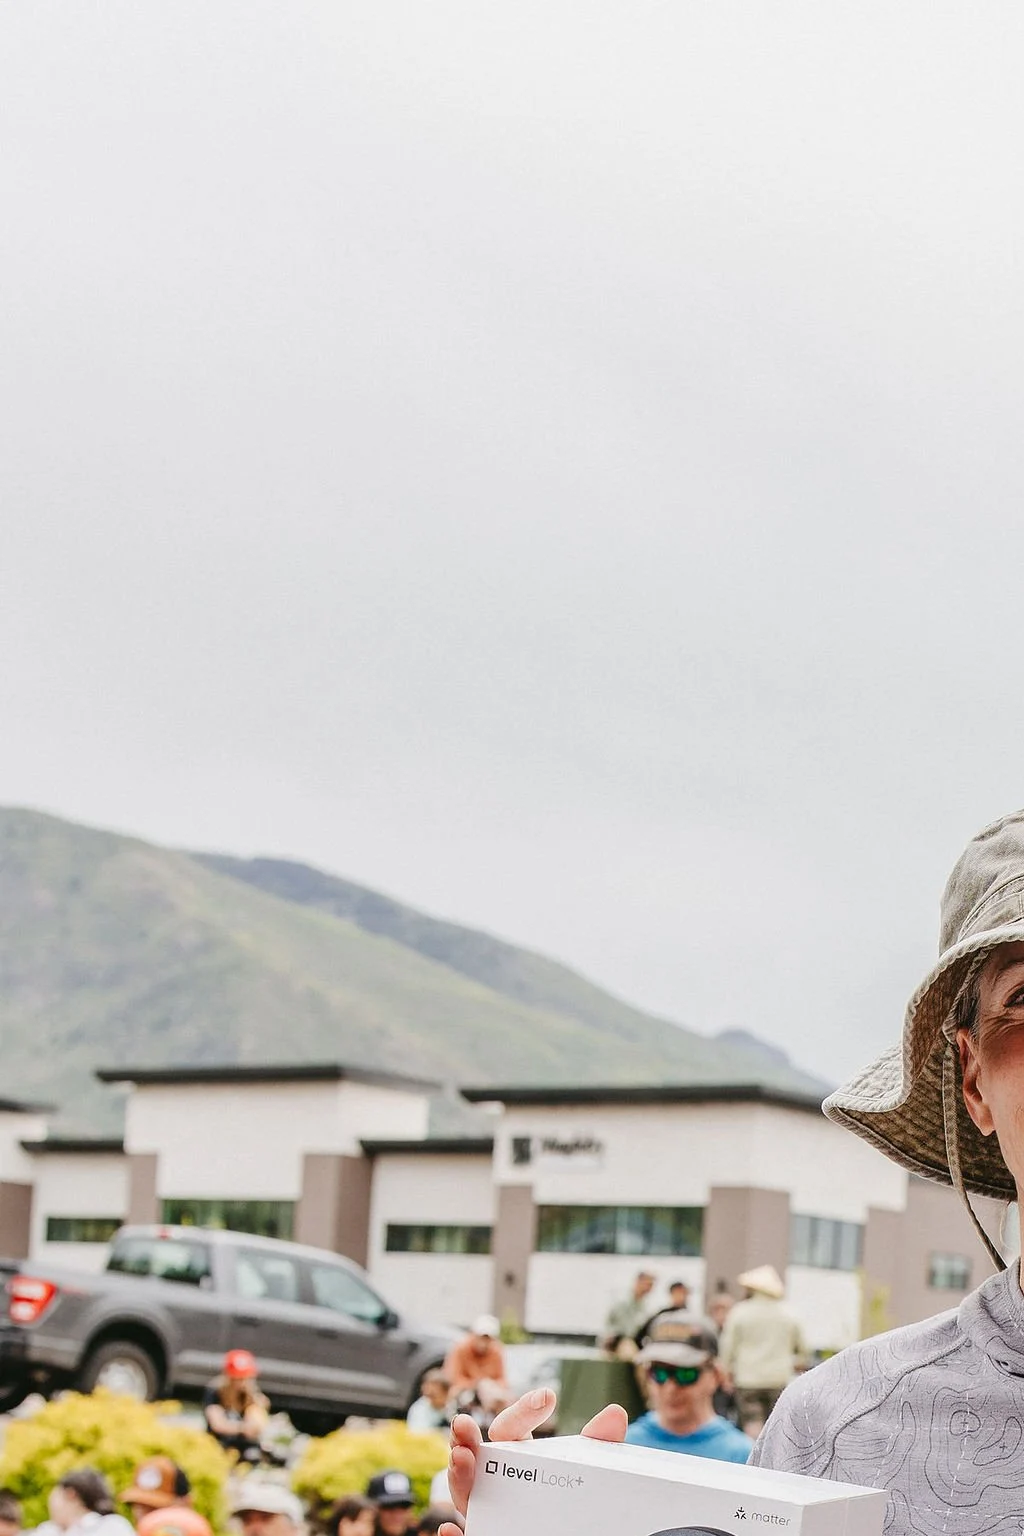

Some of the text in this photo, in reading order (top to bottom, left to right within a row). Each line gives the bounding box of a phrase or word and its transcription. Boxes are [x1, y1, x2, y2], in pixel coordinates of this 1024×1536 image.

[502, 1463, 585, 1488] level Lock+
[751, 1512, 791, 1526] matter
